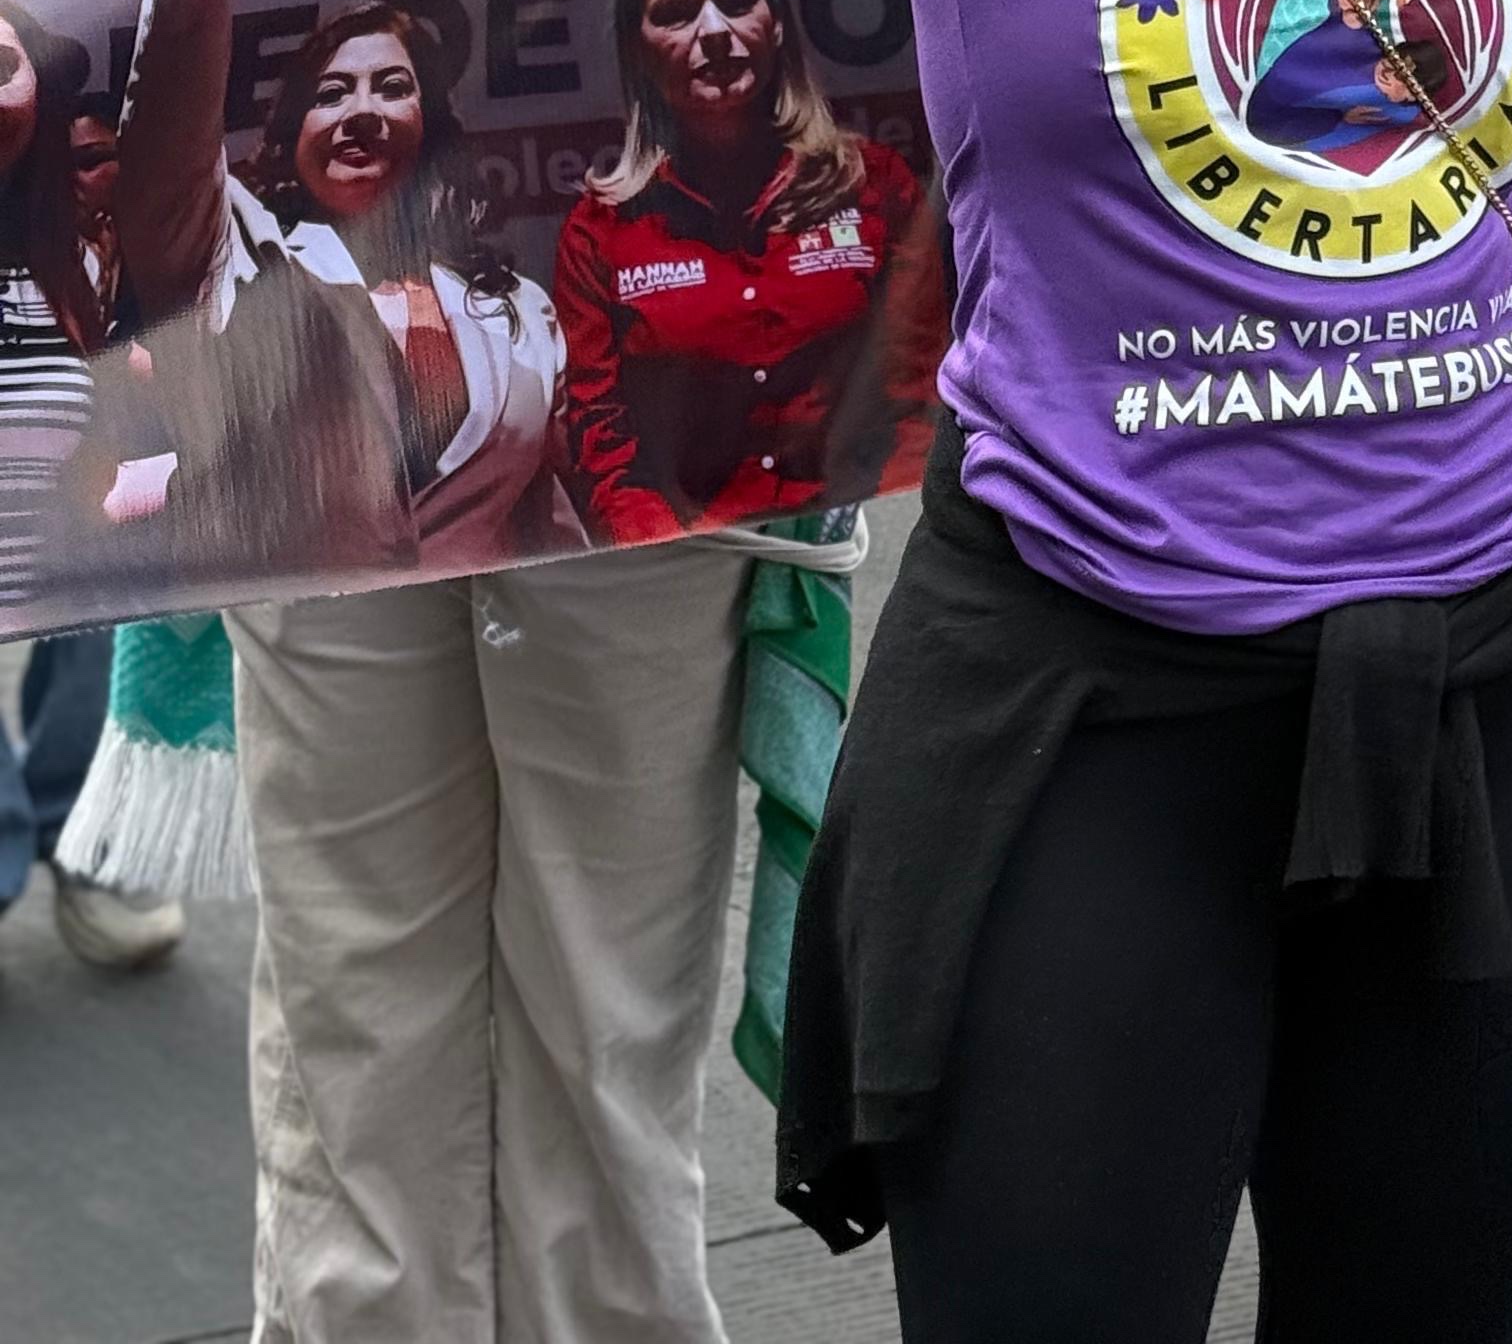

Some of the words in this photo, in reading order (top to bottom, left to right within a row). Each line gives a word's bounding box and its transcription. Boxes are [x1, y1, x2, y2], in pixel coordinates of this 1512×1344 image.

[1117, 328, 1177, 363] NO
[1190, 315, 1278, 357] MÁS
[1287, 298, 1479, 351] VIOLENCIA
